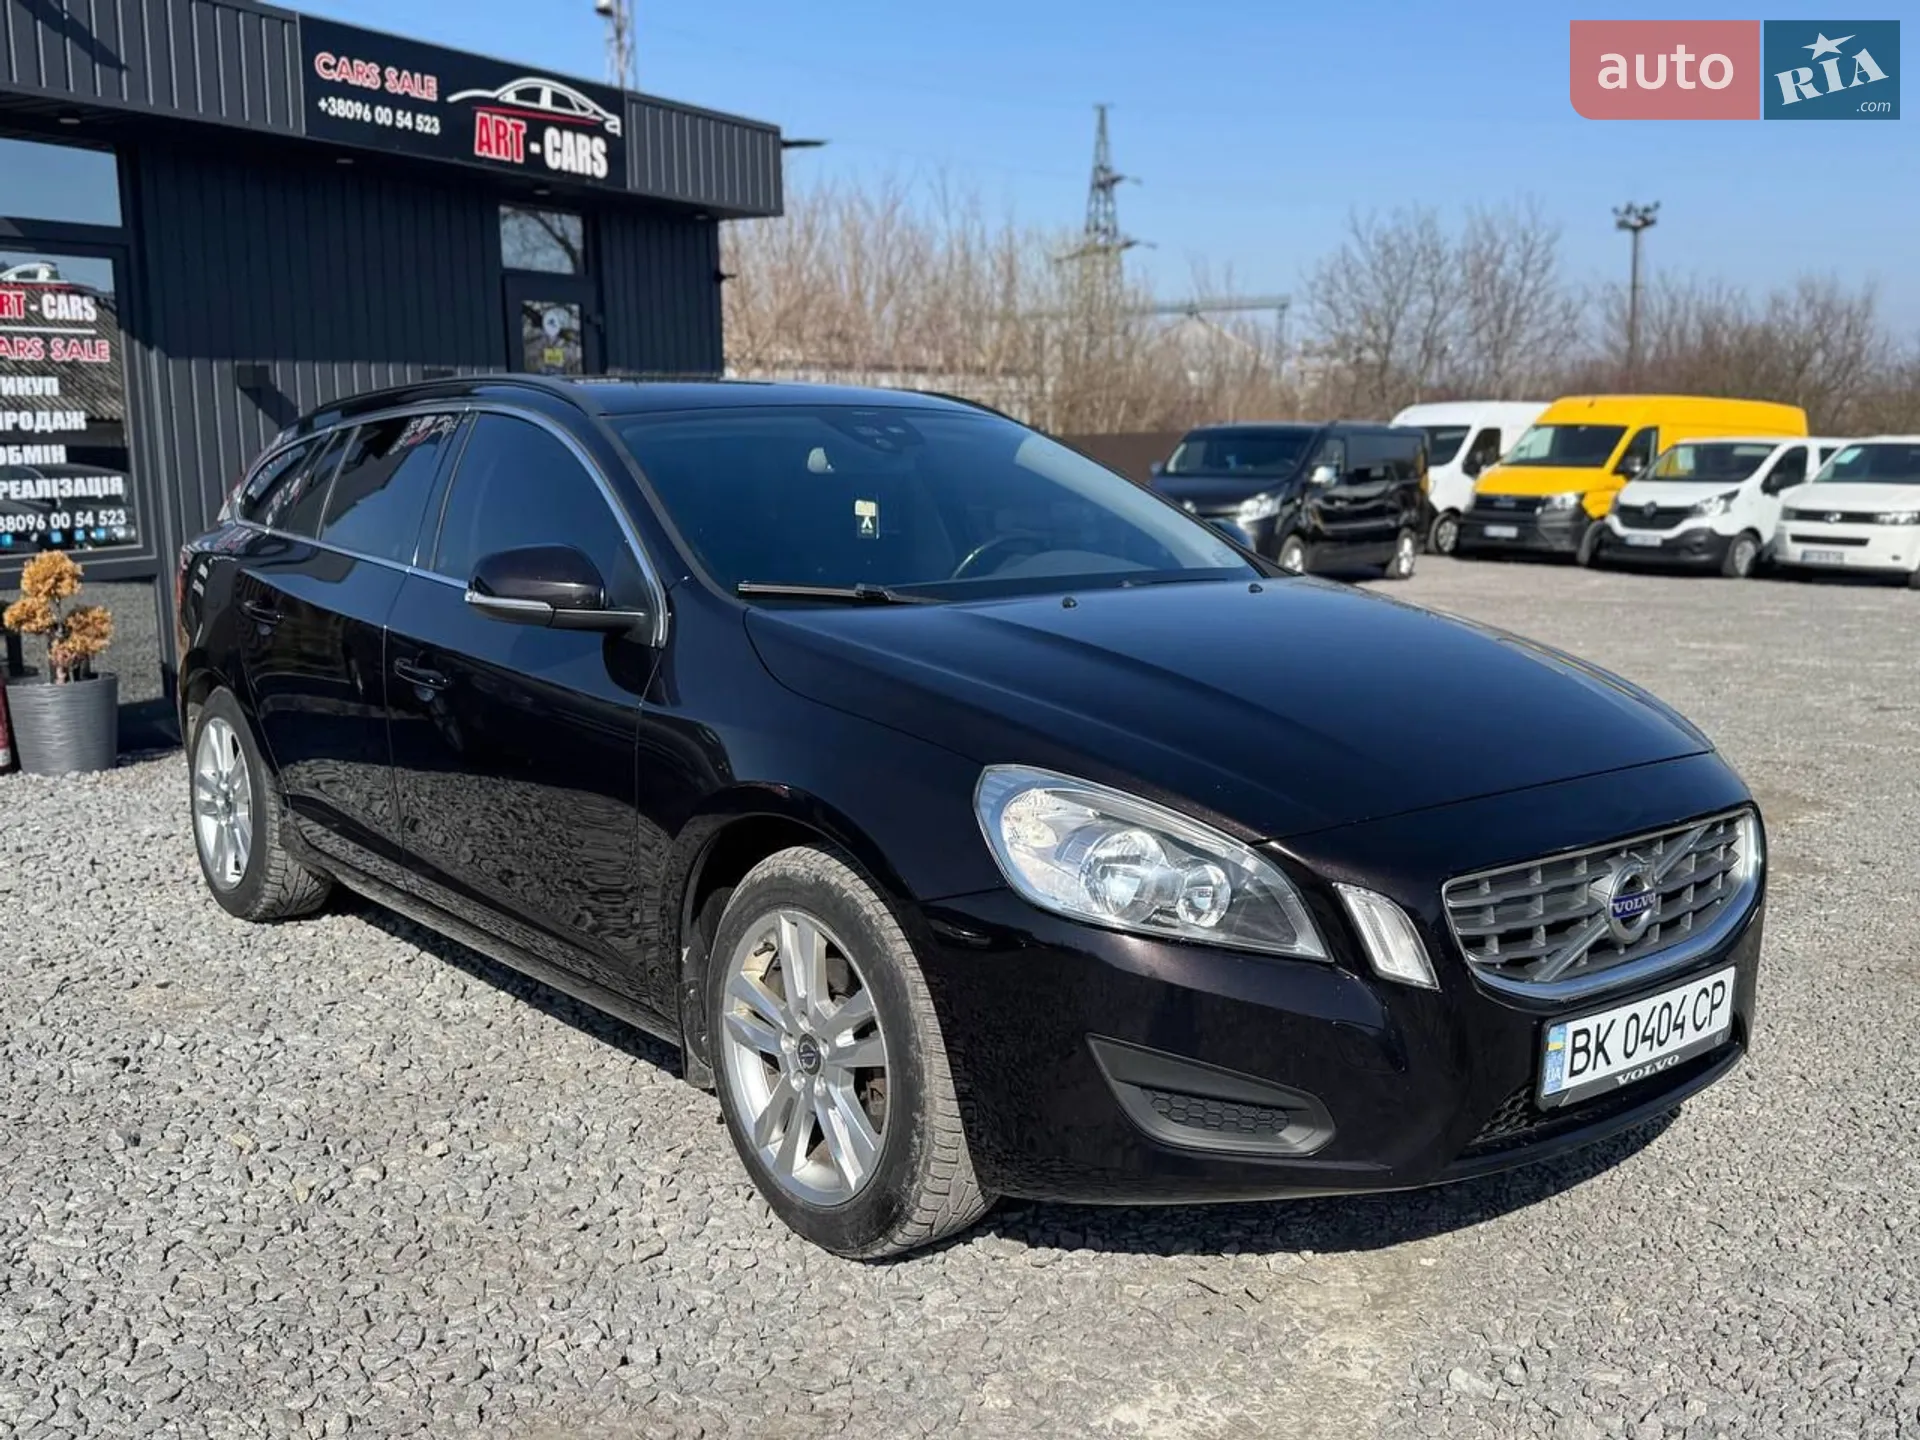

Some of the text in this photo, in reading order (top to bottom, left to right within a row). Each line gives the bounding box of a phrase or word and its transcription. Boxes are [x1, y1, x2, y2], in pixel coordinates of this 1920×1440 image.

[314, 51, 438, 102] CARS SALE
[318, 97, 441, 136] +38096 00 54 523
[474, 111, 526, 164] ART
[543, 126, 608, 179] CARS
[41, 292, 98, 322] CARS
[50, 337, 111, 363] SALE
[0, 410, 87, 433] РОДАЖ
[50, 512, 71, 530] 00
[75, 509, 95, 528] 54
[98, 508, 127, 526] 523
[1609, 892, 1656, 913] VOLVO
[1568, 979, 1726, 1079] BK 0404 CP
[1615, 1054, 1680, 1086] VOLVO
